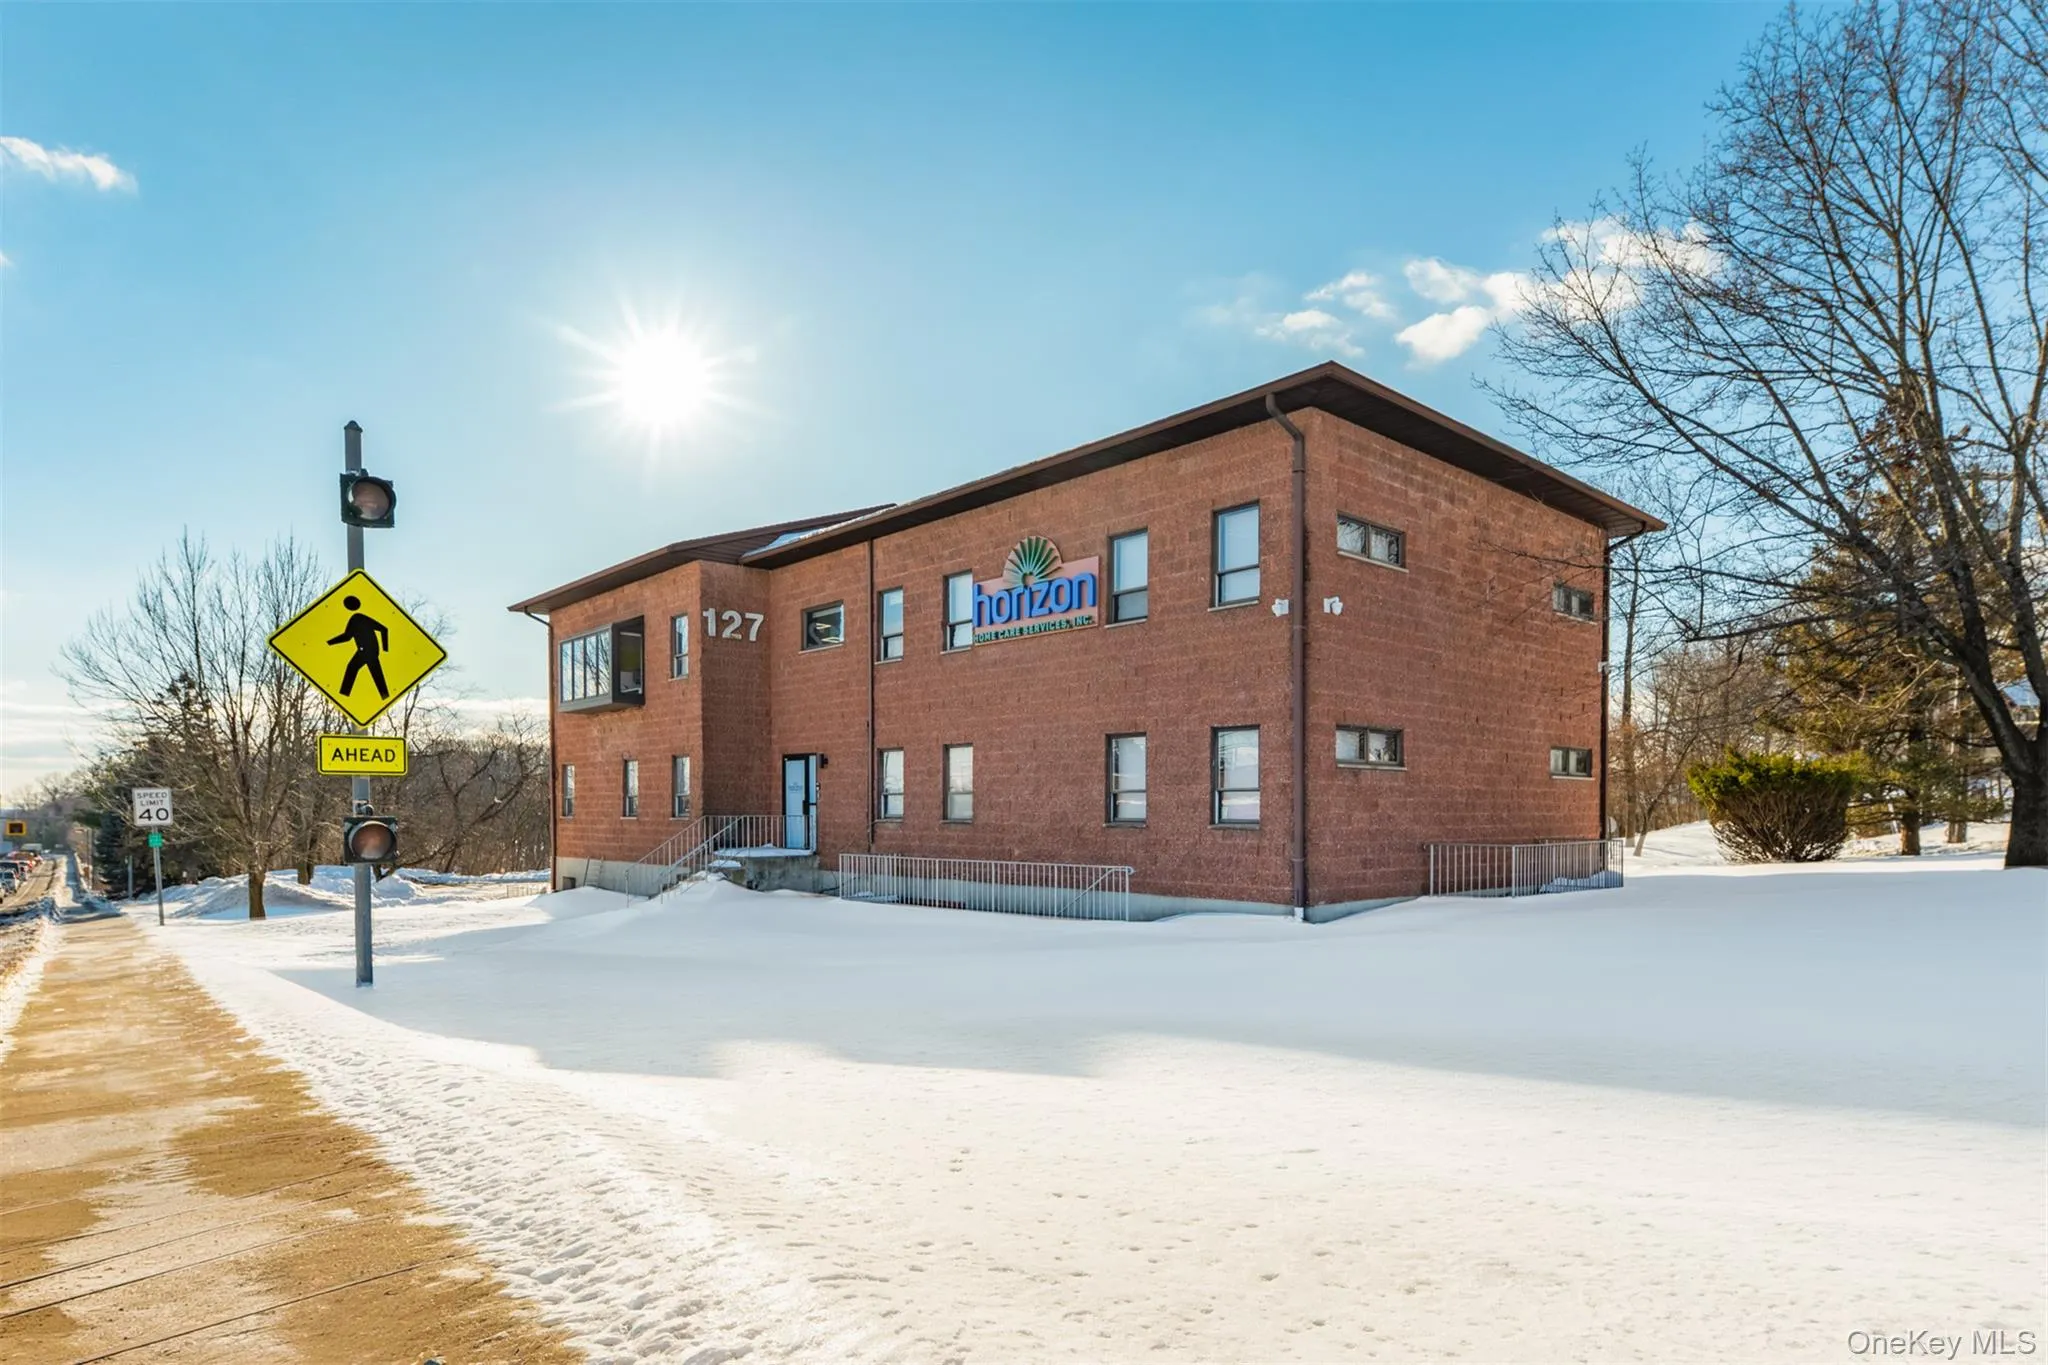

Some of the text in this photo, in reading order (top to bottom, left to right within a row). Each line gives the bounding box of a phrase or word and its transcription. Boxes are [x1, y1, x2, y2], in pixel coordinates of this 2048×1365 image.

[973, 572, 1097, 628] horizon
[702, 607, 764, 642] 127
[974, 630, 998, 643] HOME
[999, 626, 1021, 639] CARE
[1073, 615, 1093, 627] INC.
[331, 747, 396, 763] AHEAD
[139, 808, 169, 821] 40
